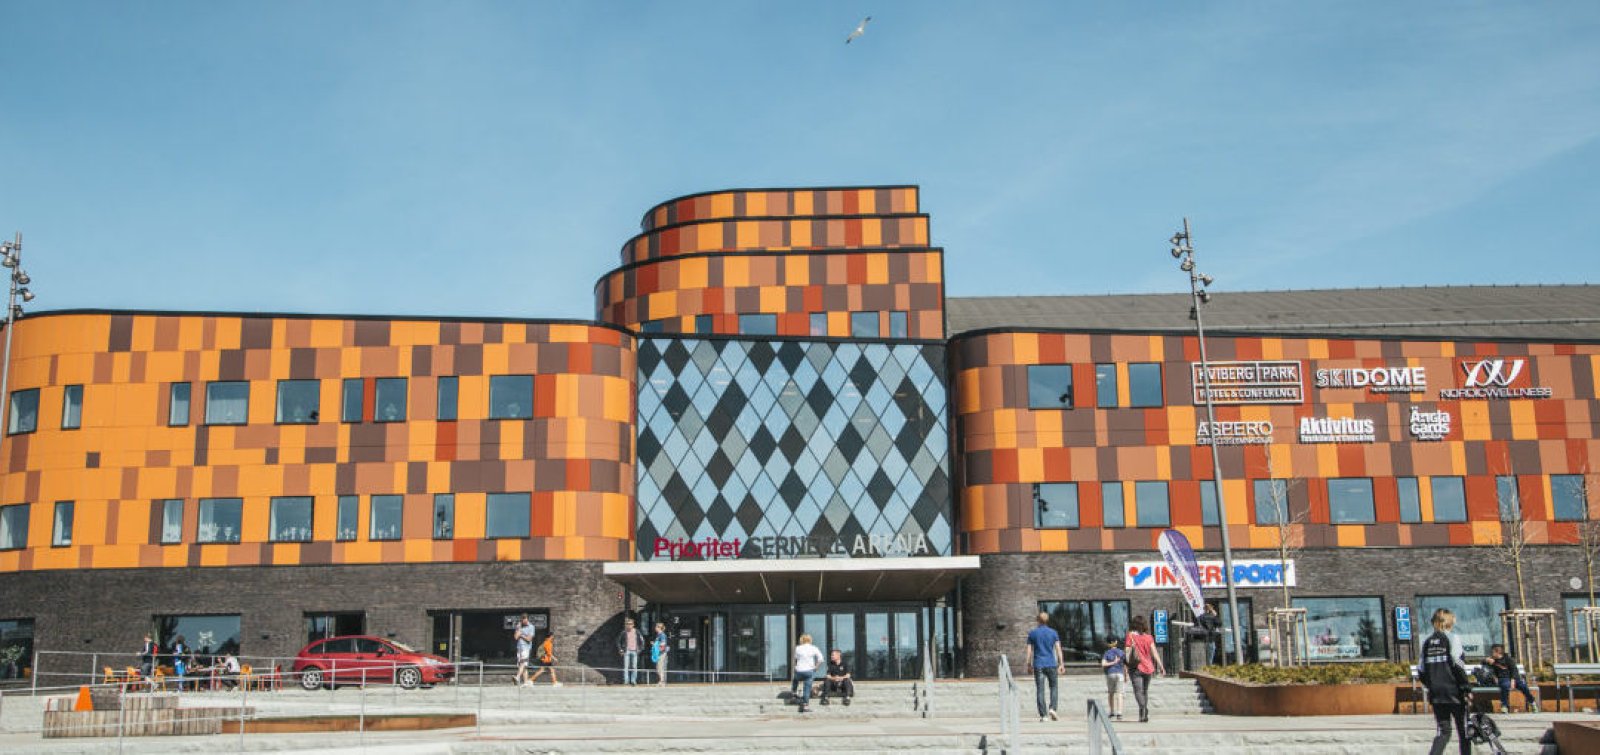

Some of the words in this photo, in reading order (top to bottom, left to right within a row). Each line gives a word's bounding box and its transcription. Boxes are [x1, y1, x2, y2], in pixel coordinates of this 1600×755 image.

[1262, 366, 1297, 379] PARK
[1300, 416, 1375, 435] Aktivitus
[654, 537, 742, 557] Prioritet
[747, 536, 847, 556] SERNEE
[851, 533, 929, 555] ARENA
[1154, 563, 1290, 586] INERSPORT
[1158, 611, 1165, 622] P
[1400, 607, 1407, 618] P
